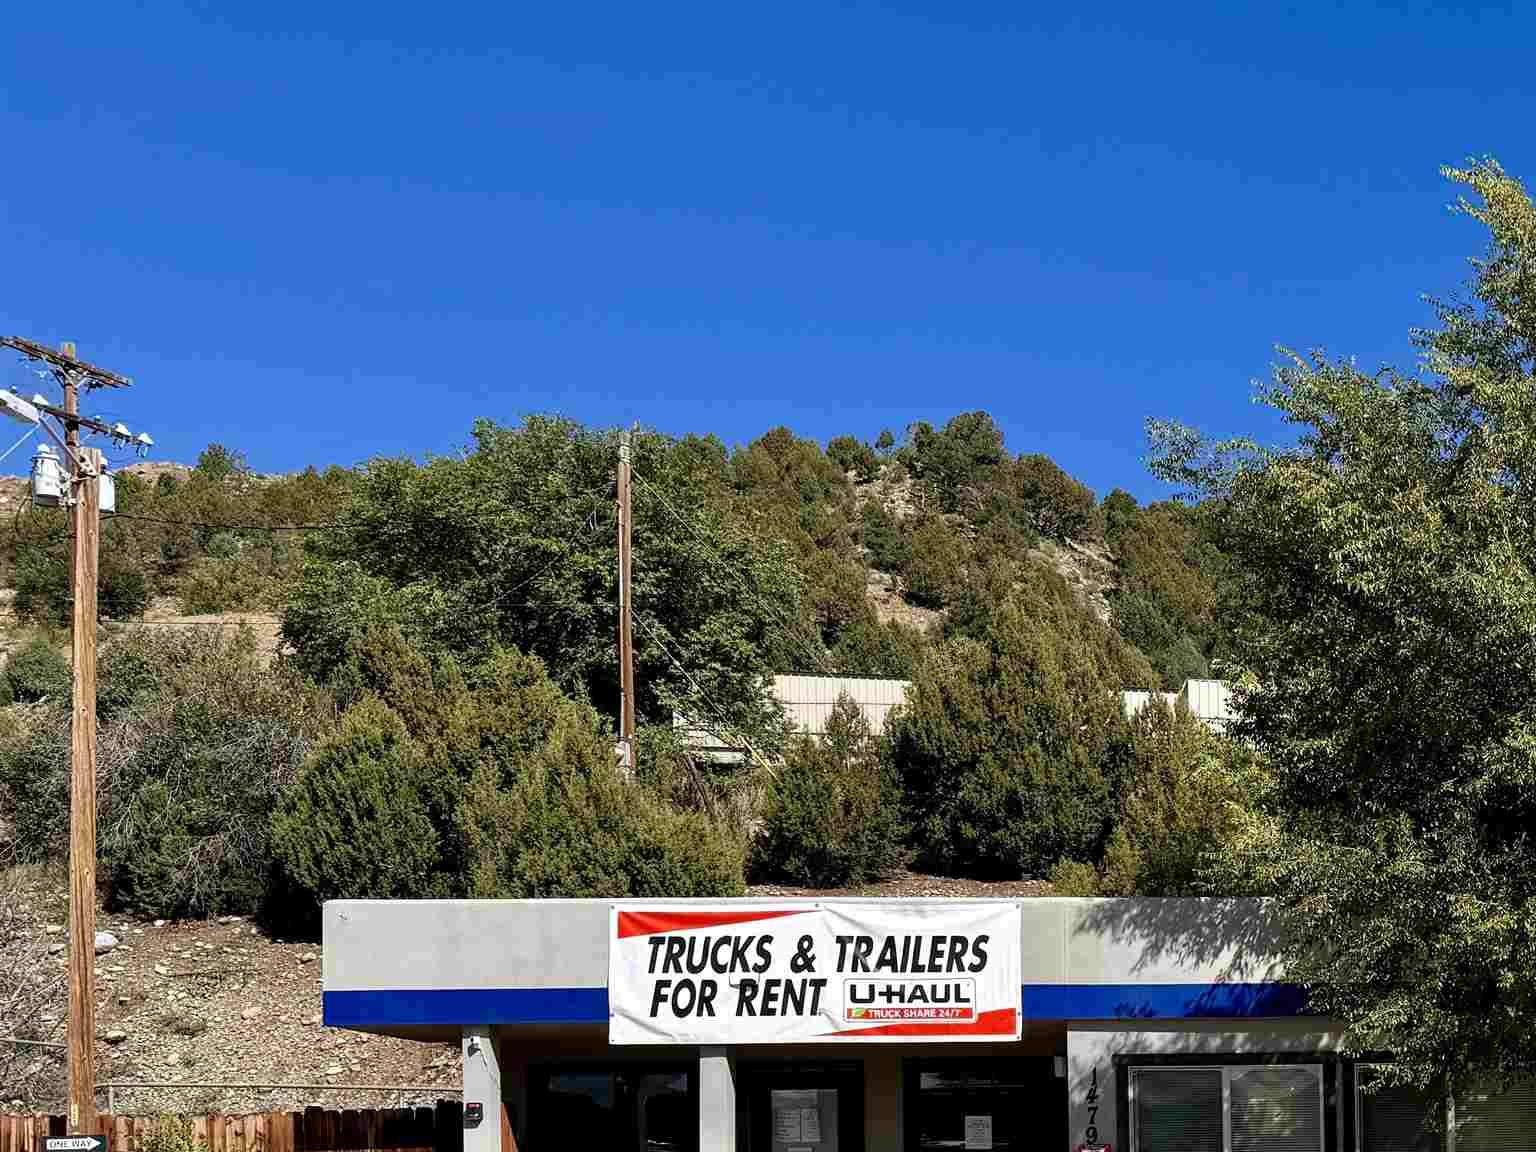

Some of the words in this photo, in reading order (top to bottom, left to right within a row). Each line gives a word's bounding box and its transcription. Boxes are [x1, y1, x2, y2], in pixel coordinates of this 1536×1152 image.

[647, 935, 773, 974] TRUCKS
[789, 934, 816, 973] &
[836, 935, 990, 973] TRAILERS
[649, 978, 717, 1017] FOR
[735, 978, 827, 1017] RENT
[850, 984, 971, 1004] U-HAUL
[869, 1008, 901, 1018] TRUCK
[903, 1008, 937, 1018] SHARE
[939, 1008, 962, 1018] 24/7
[49, 1139, 70, 1148] ONE
[72, 1139, 92, 1147] WAY
